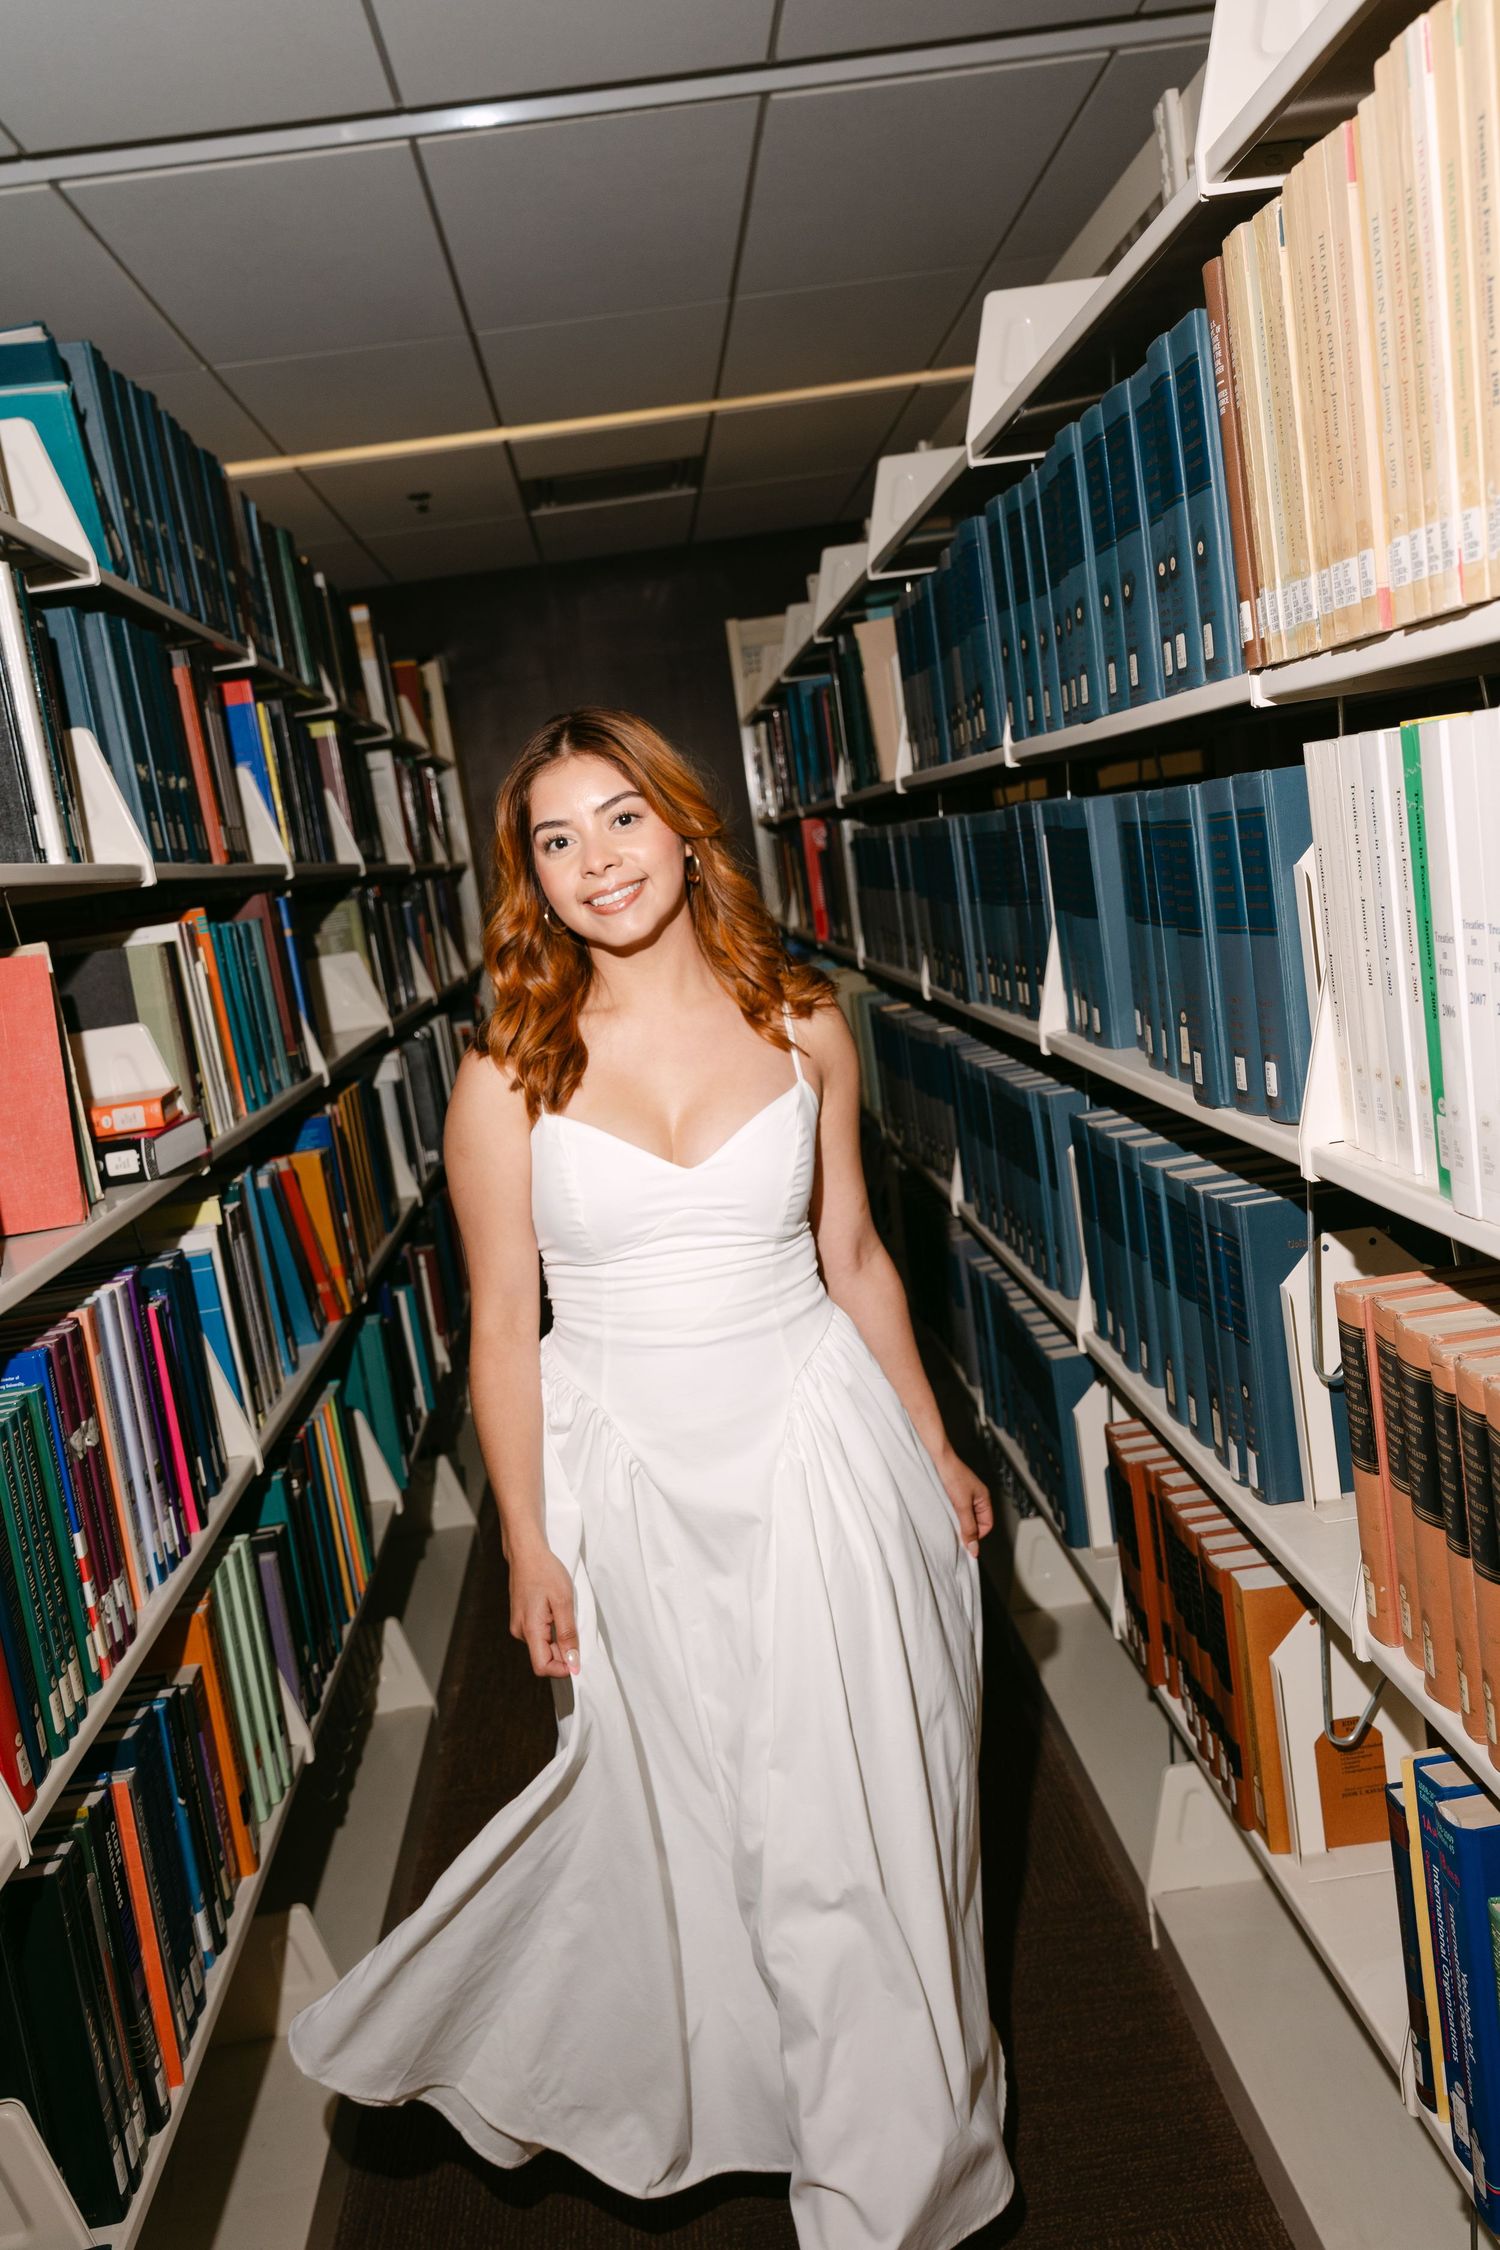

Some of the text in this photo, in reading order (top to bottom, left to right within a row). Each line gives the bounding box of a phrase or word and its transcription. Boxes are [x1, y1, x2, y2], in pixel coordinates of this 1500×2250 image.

[1317, 233, 1330, 303] TREATIES
[1324, 309, 1331, 326] IN
[1370, 213, 1384, 290] TREATIES
[1377, 297, 1385, 314] IN
[1411, 271, 1419, 288] IN
[1349, 781, 1359, 829] Treaties
[1369, 785, 1378, 833] Treaties
[1394, 787, 1405, 836] Treaties
[1413, 789, 1424, 841] Treaties
[1354, 833, 1359, 844] in
[1374, 839, 1380, 849] in
[1400, 840, 1405, 852] in
[1418, 847, 1423, 858] in
[1355, 848, 1364, 881] Force
[1375, 855, 1383, 887] Force
[1401, 857, 1409, 891] Force
[1419, 865, 1427, 900] Force
[1359, 895, 1369, 942] January
[1379, 902, 1388, 949] January
[1404, 906, 1415, 955] January
[1435, 931, 1454, 944] Treaties
[1462, 920, 1485, 930] Treaties
[1422, 916, 1433, 969] January
[1467, 955, 1484, 967] Force
[1439, 964, 1453, 977] Force
[1470, 991, 1486, 1006] 2007
[11, 1430, 56, 1619] ENCYCLOPEDIA OF FAMILY LIFE
[21, 1419, 64, 1605] ENCYCLOPEDIA OF FAMILY LIFE
[0, 1439, 45, 1633] ENCYCLOPEDIA OF FAMILY LIFE
[109, 1820, 122, 1865] OLDER
[105, 1831, 124, 1909] AMERICANS
[1429, 1862, 1460, 2064] International Organizations
[1447, 1903, 1465, 2002] International
[1459, 1972, 1476, 2064] Yearbook of
